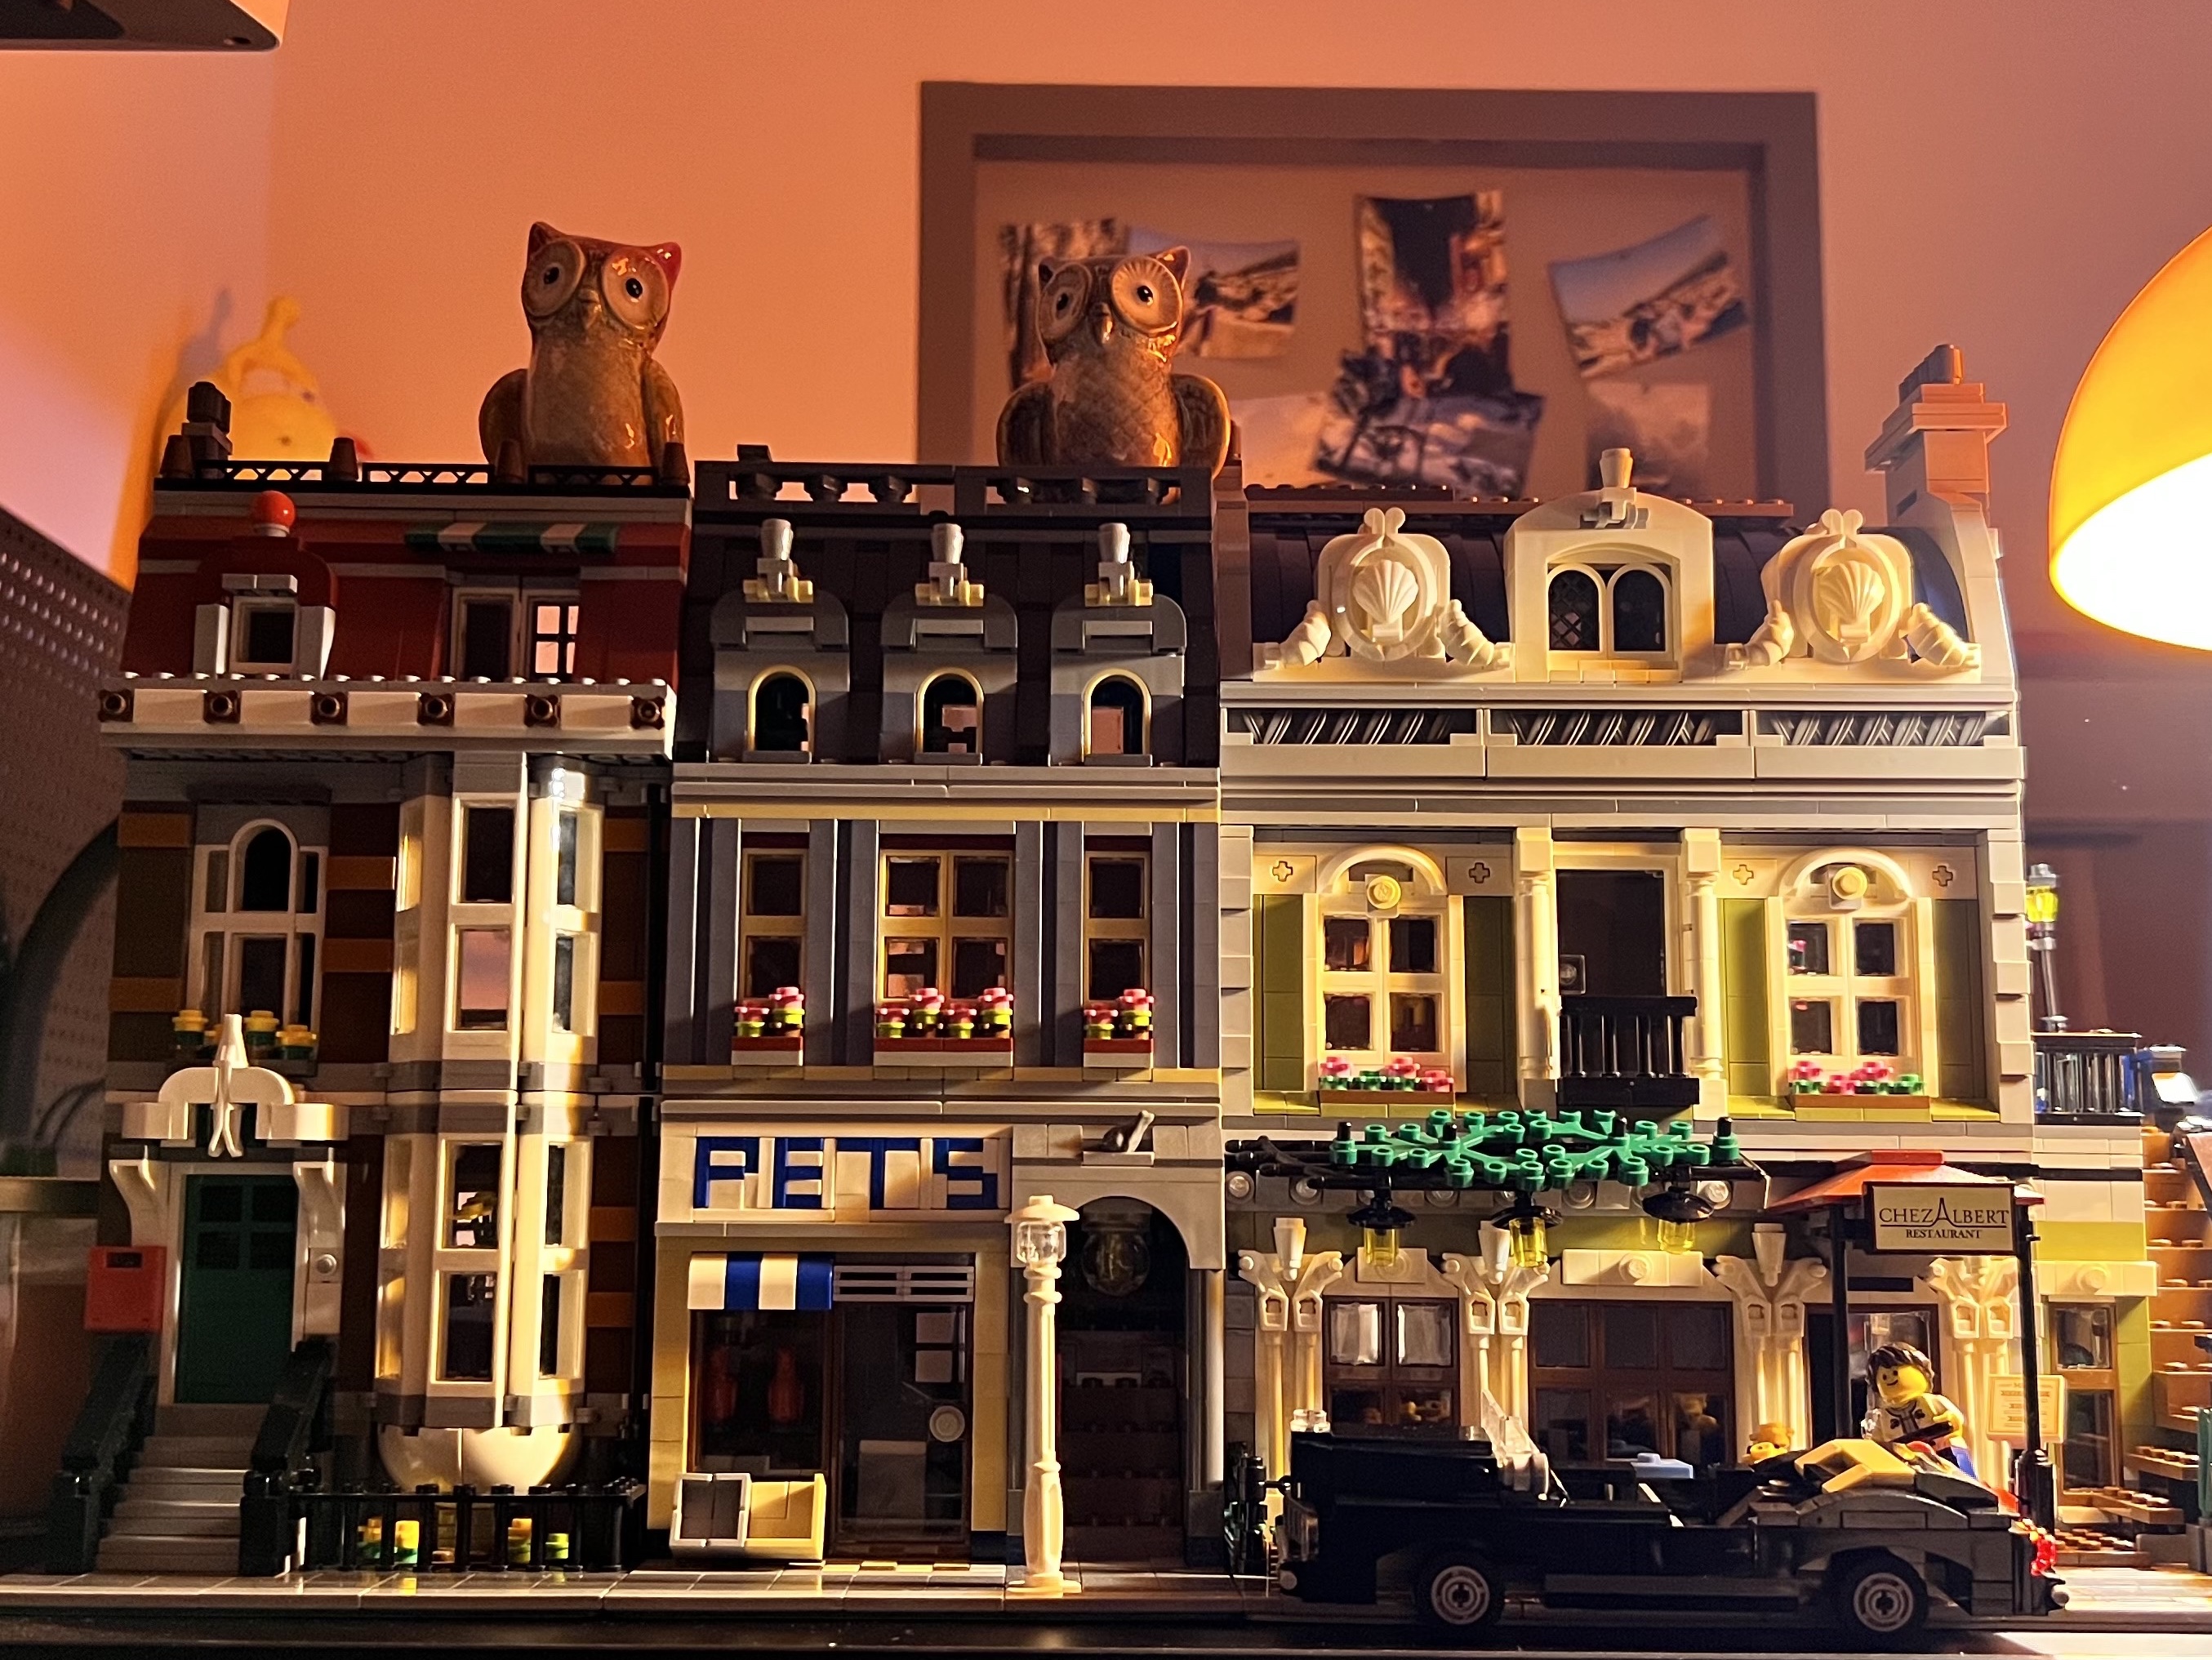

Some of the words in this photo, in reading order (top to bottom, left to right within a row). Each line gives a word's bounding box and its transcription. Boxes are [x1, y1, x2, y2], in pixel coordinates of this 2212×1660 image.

[693, 1137, 998, 1208] PETS
[1879, 1208, 1933, 1223] CHEZ
[1933, 1197, 2009, 1225] ALBERT
[1906, 1229, 1983, 1239] RESTAURANT
